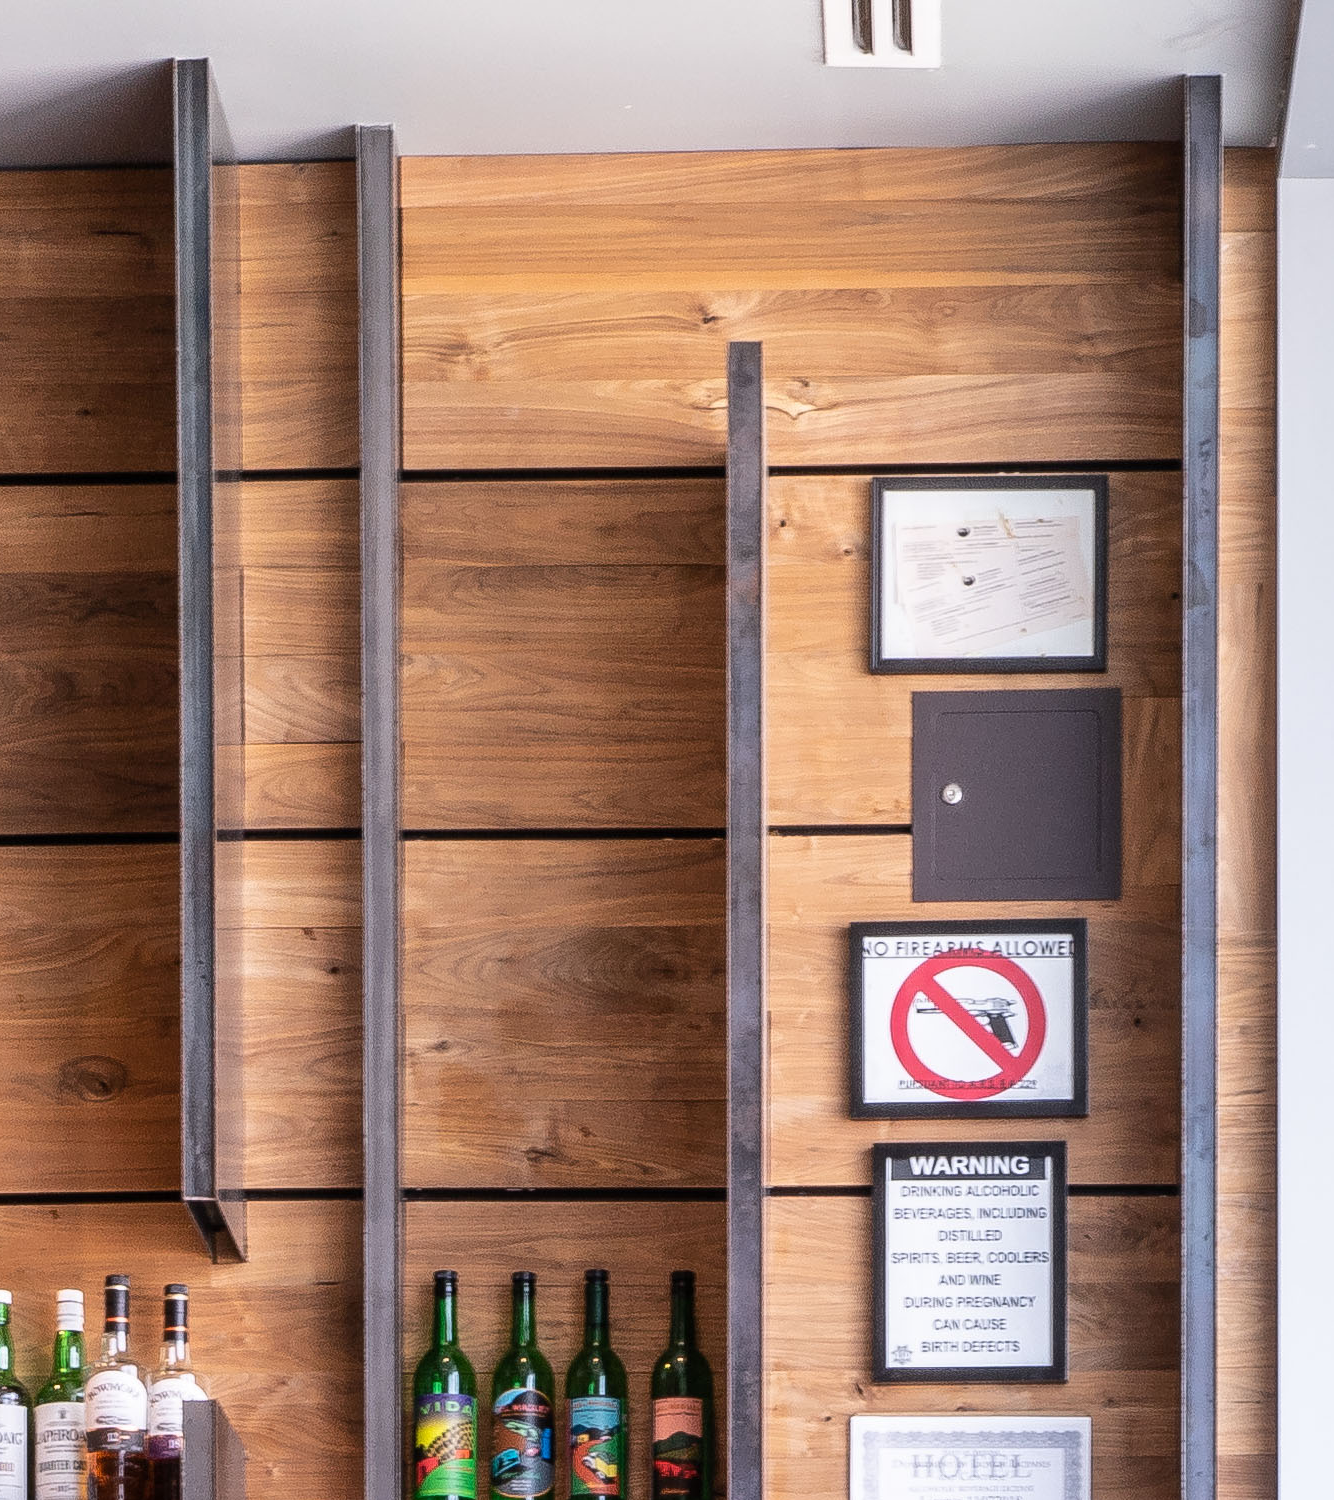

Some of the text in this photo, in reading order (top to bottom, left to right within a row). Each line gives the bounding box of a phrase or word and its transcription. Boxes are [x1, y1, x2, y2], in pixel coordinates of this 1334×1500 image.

[897, 941, 986, 956] FIREARMS
[908, 1157, 1030, 1175] WARNING
[901, 1185, 1040, 1197] DRINKING ALCOHOLIC
[893, 1207, 1047, 1220] BEVERAGES, INCLUDING
[938, 1230, 1002, 1242] DISTILLED
[891, 1252, 1050, 1264] SPIRITS, BEER, COOLERS
[938, 1274, 1001, 1285] AND WINE
[904, 1296, 1036, 1308] DURING PREGNANCY
[933, 1319, 1007, 1330] CAN CAUSE
[921, 1341, 1020, 1352] BIRTH DEFECTS
[912, 1454, 1032, 1479] HOTEL
